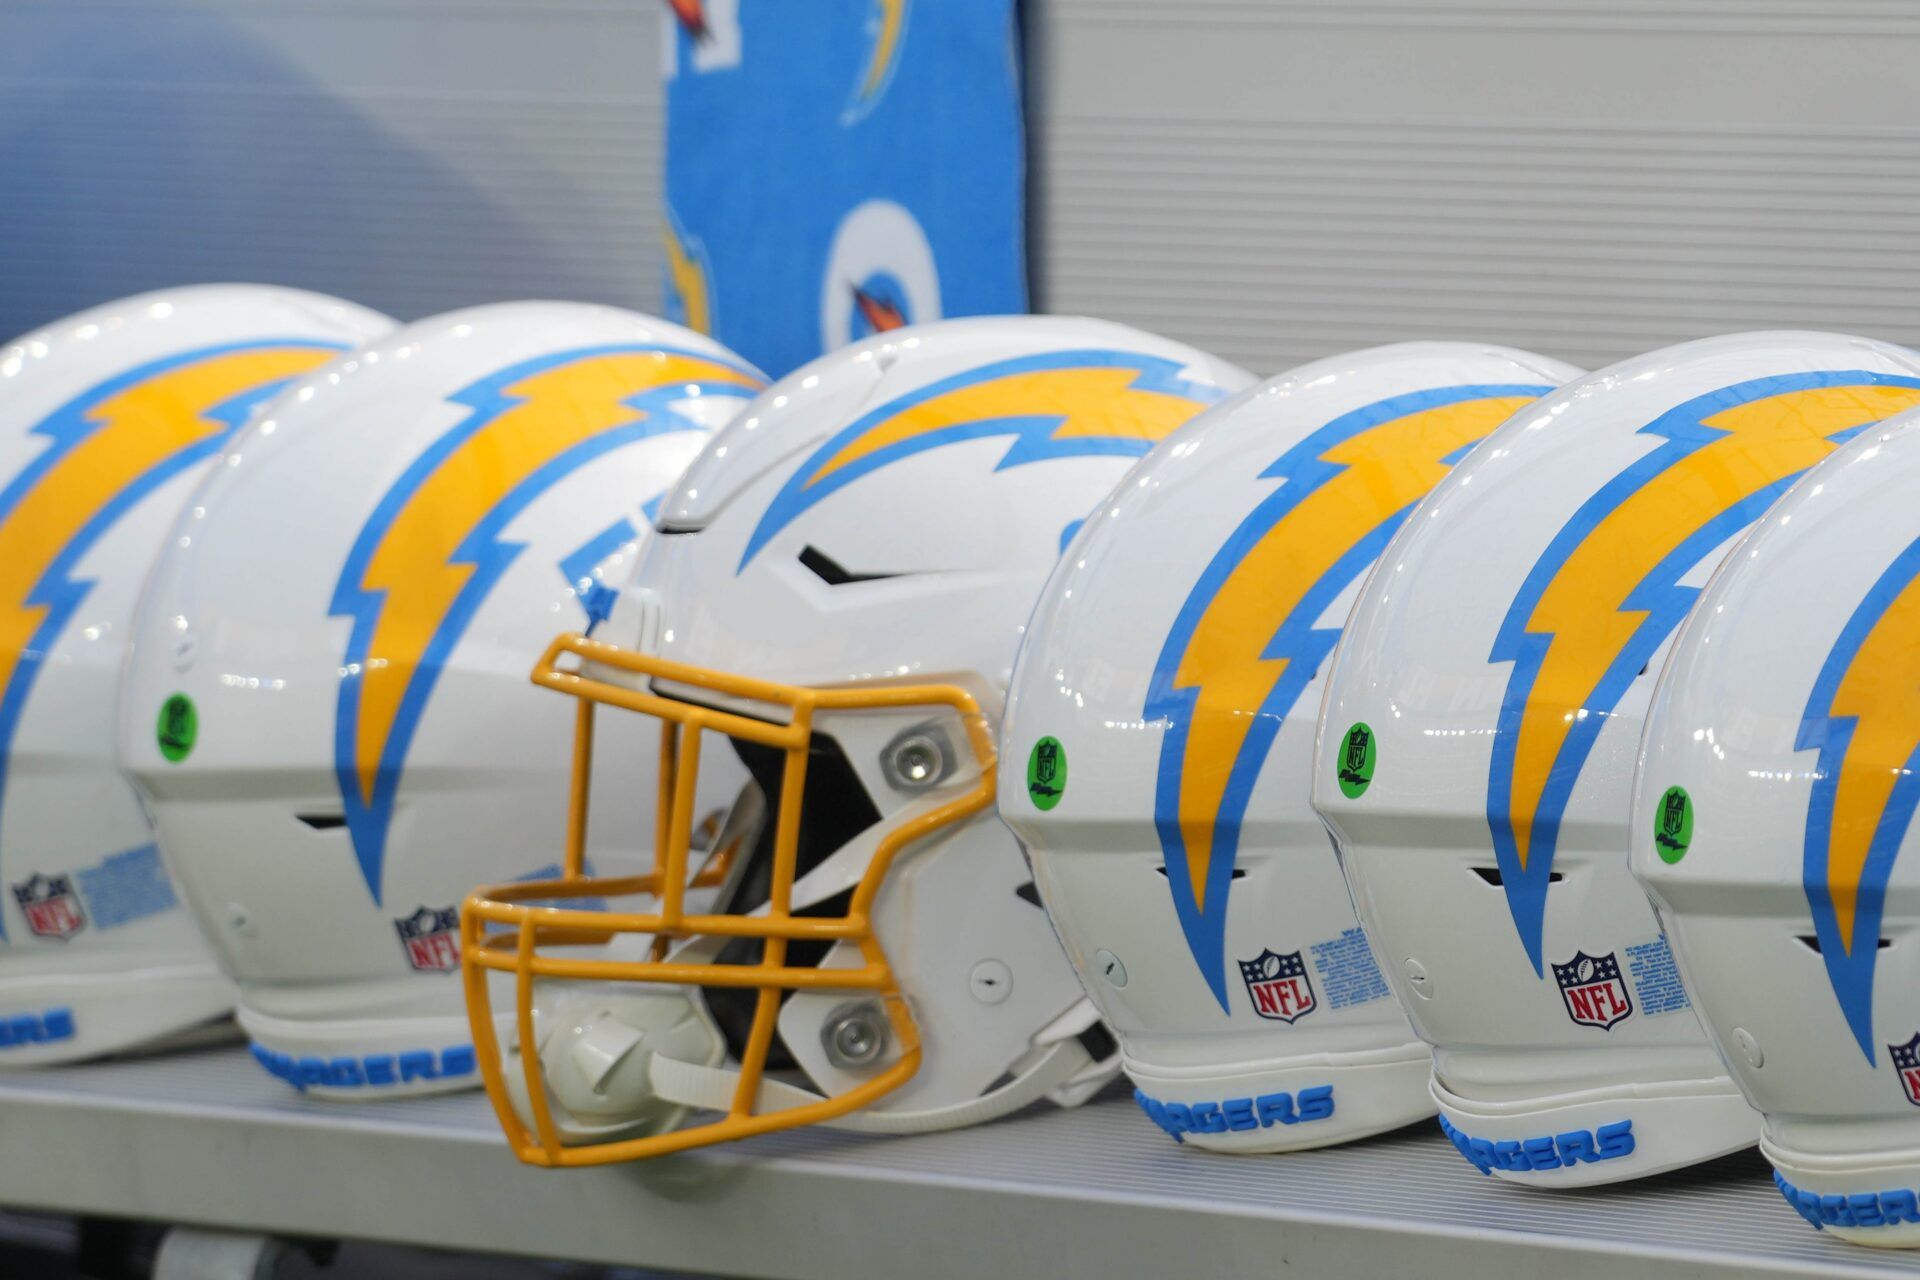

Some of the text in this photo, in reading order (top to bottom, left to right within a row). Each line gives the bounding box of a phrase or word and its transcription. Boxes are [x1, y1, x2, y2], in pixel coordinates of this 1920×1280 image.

[27, 899, 82, 933] NFL
[1253, 979, 1312, 1016] NFL
[1567, 983, 1627, 1021] NFL
